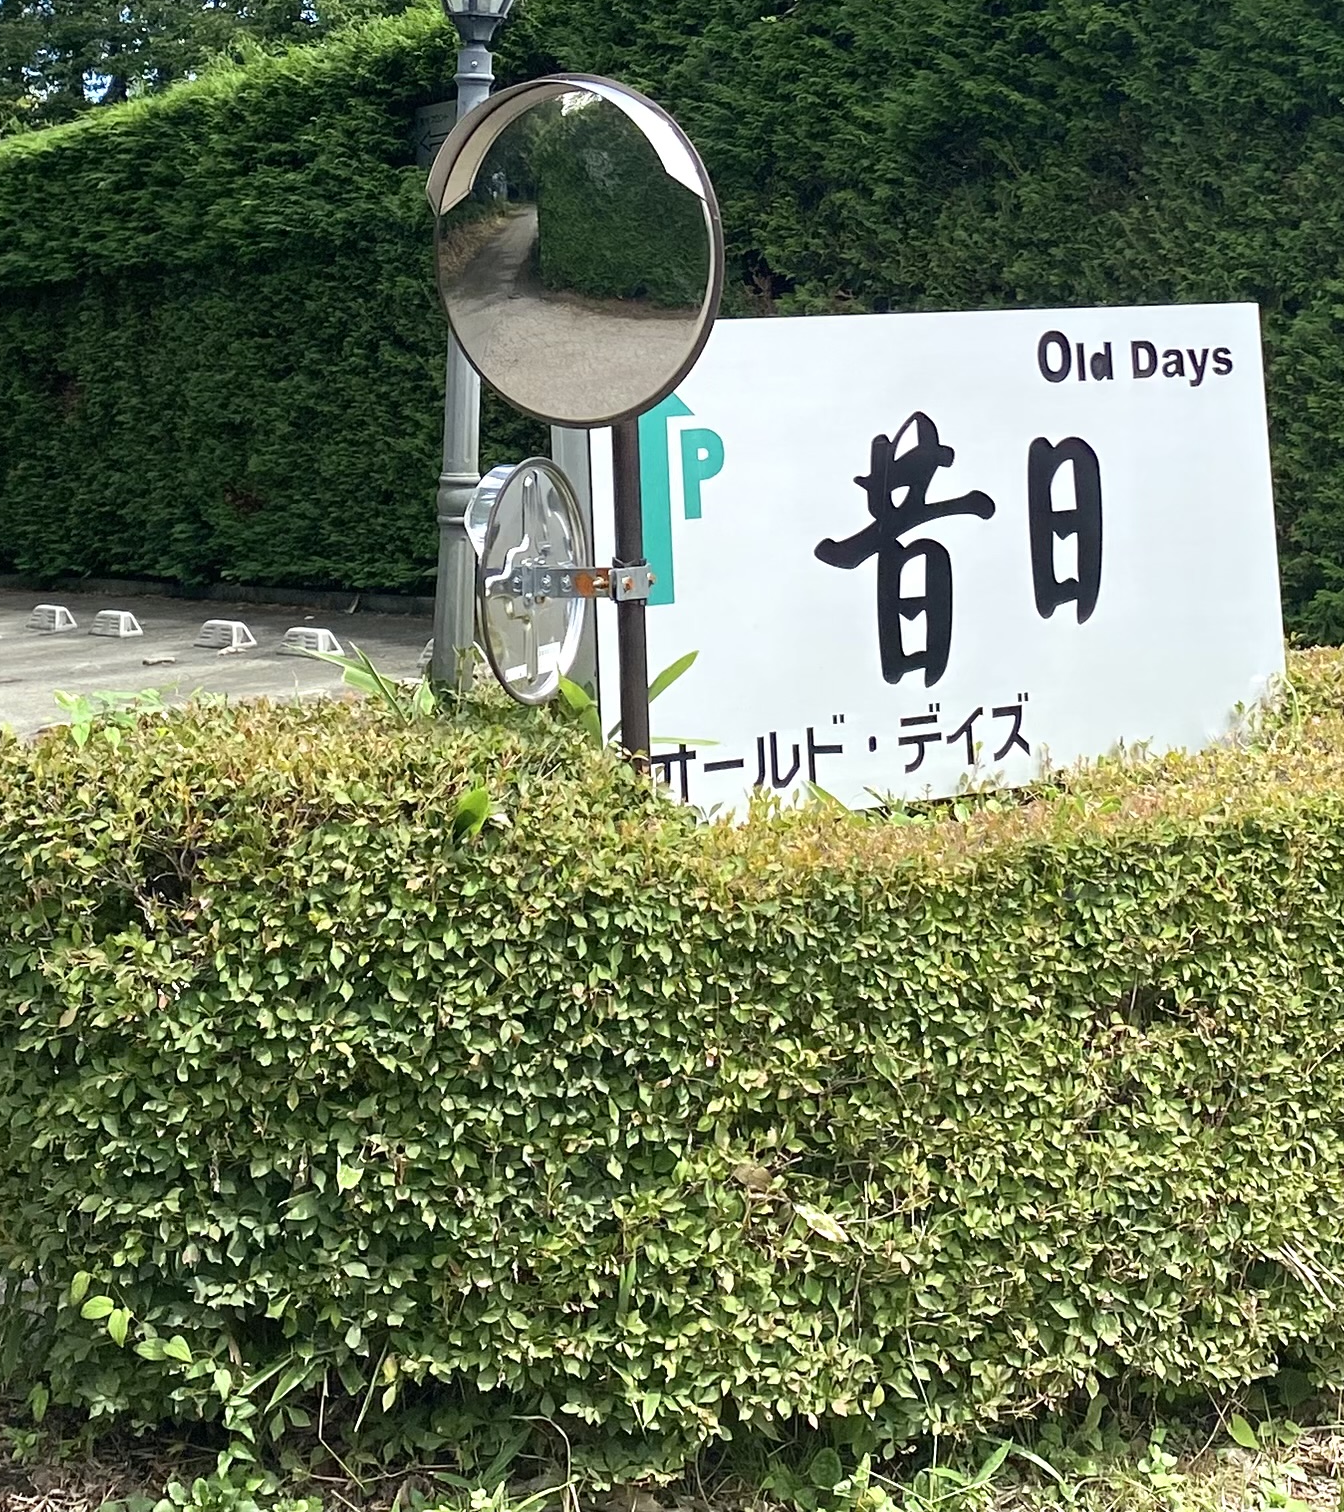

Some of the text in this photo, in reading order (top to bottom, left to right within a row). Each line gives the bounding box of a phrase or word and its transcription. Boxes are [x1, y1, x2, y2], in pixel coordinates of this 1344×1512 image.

[1037, 330, 1234, 387] Old Days
[680, 428, 725, 520] P
[813, 410, 1104, 689] 昔日
